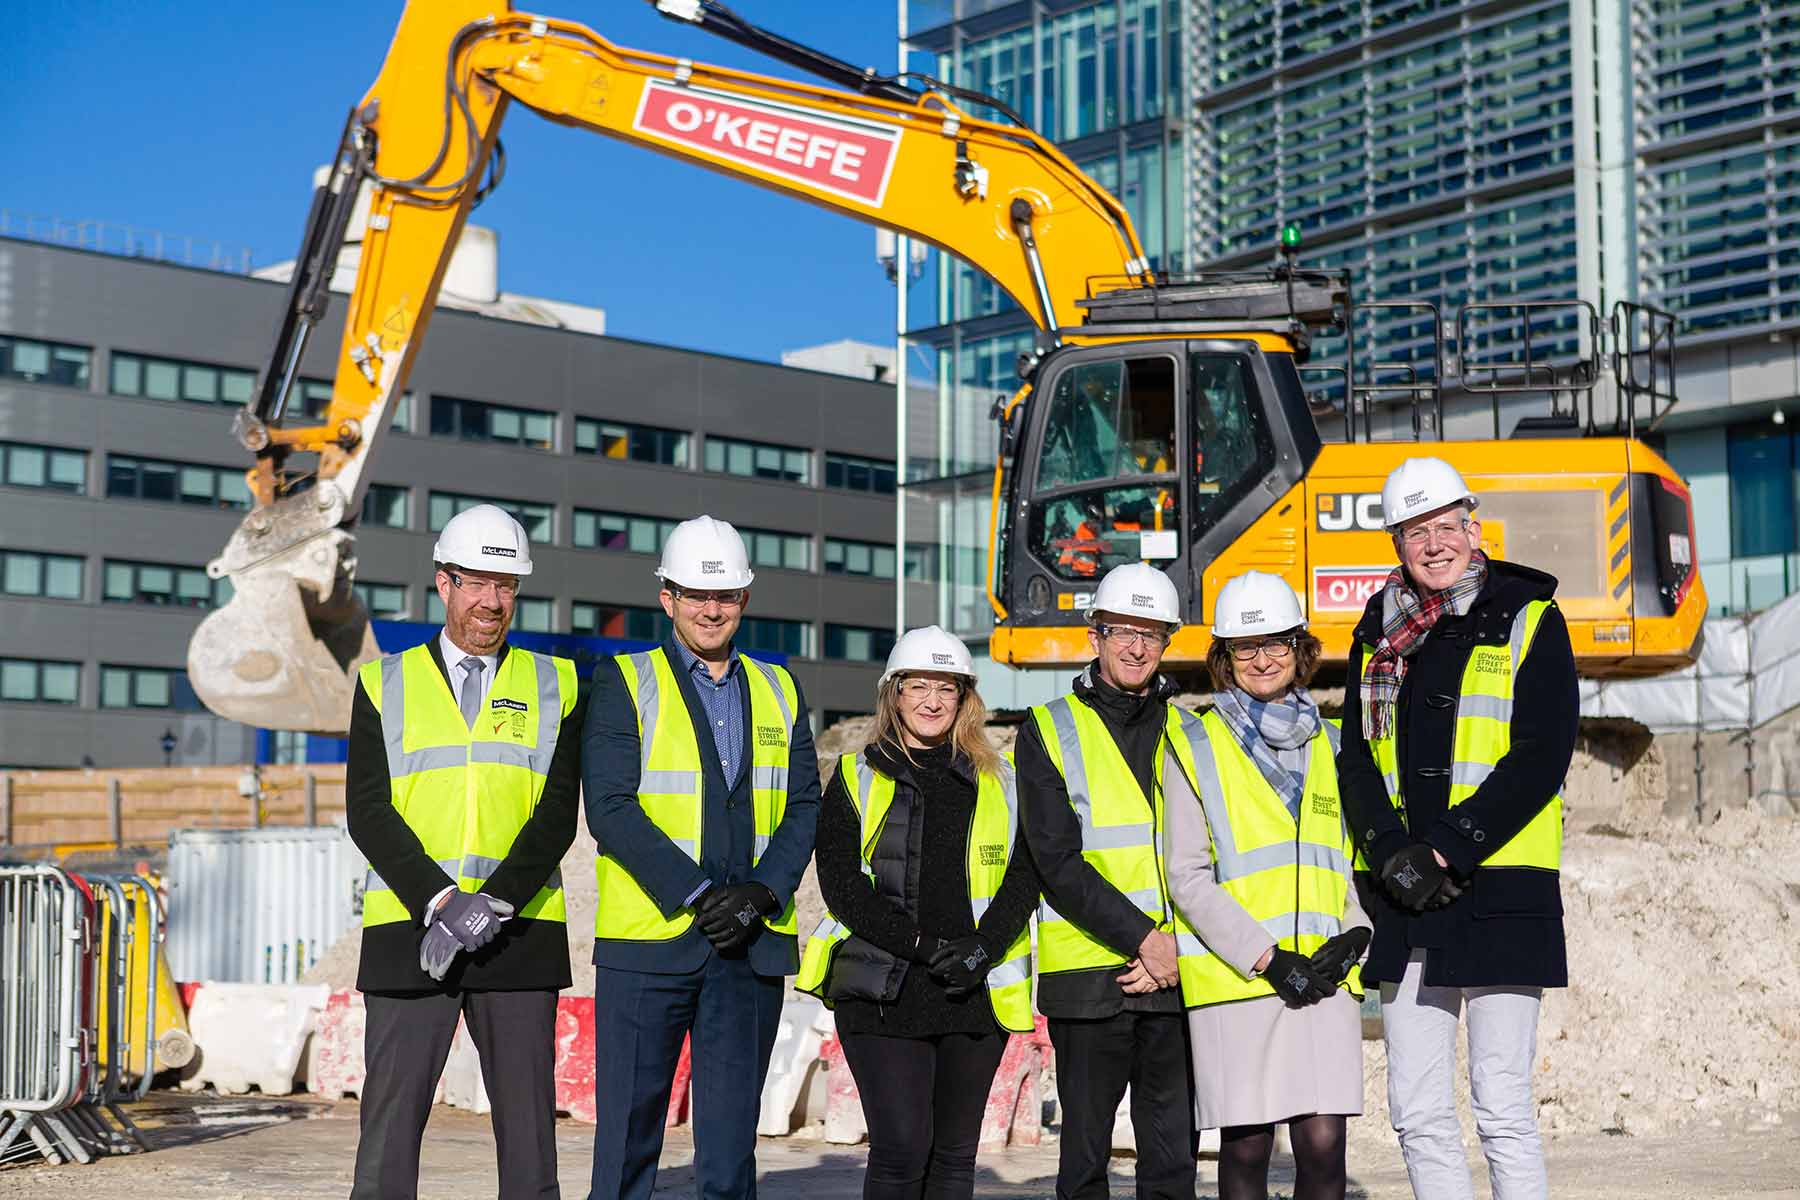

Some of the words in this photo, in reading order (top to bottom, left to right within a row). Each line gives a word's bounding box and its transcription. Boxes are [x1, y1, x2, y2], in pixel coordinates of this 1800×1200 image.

[665, 101, 867, 182] O'KEEFE
[1318, 493, 1385, 531] JC
[1478, 652, 1511, 662] EDWARD
[1477, 660, 1504, 668] STREET
[1475, 666, 1511, 676] QUARTER
[757, 726, 784, 734] EDWARD
[759, 739, 787, 748] QUARTER
[1312, 793, 1337, 804] EDWARD
[1312, 800, 1332, 810] STREET
[1312, 807, 1339, 818] QUARTER
[979, 844, 1005, 853] EDWARD
[980, 851, 1001, 859] STREET
[980, 858, 1006, 866] QUARTER
